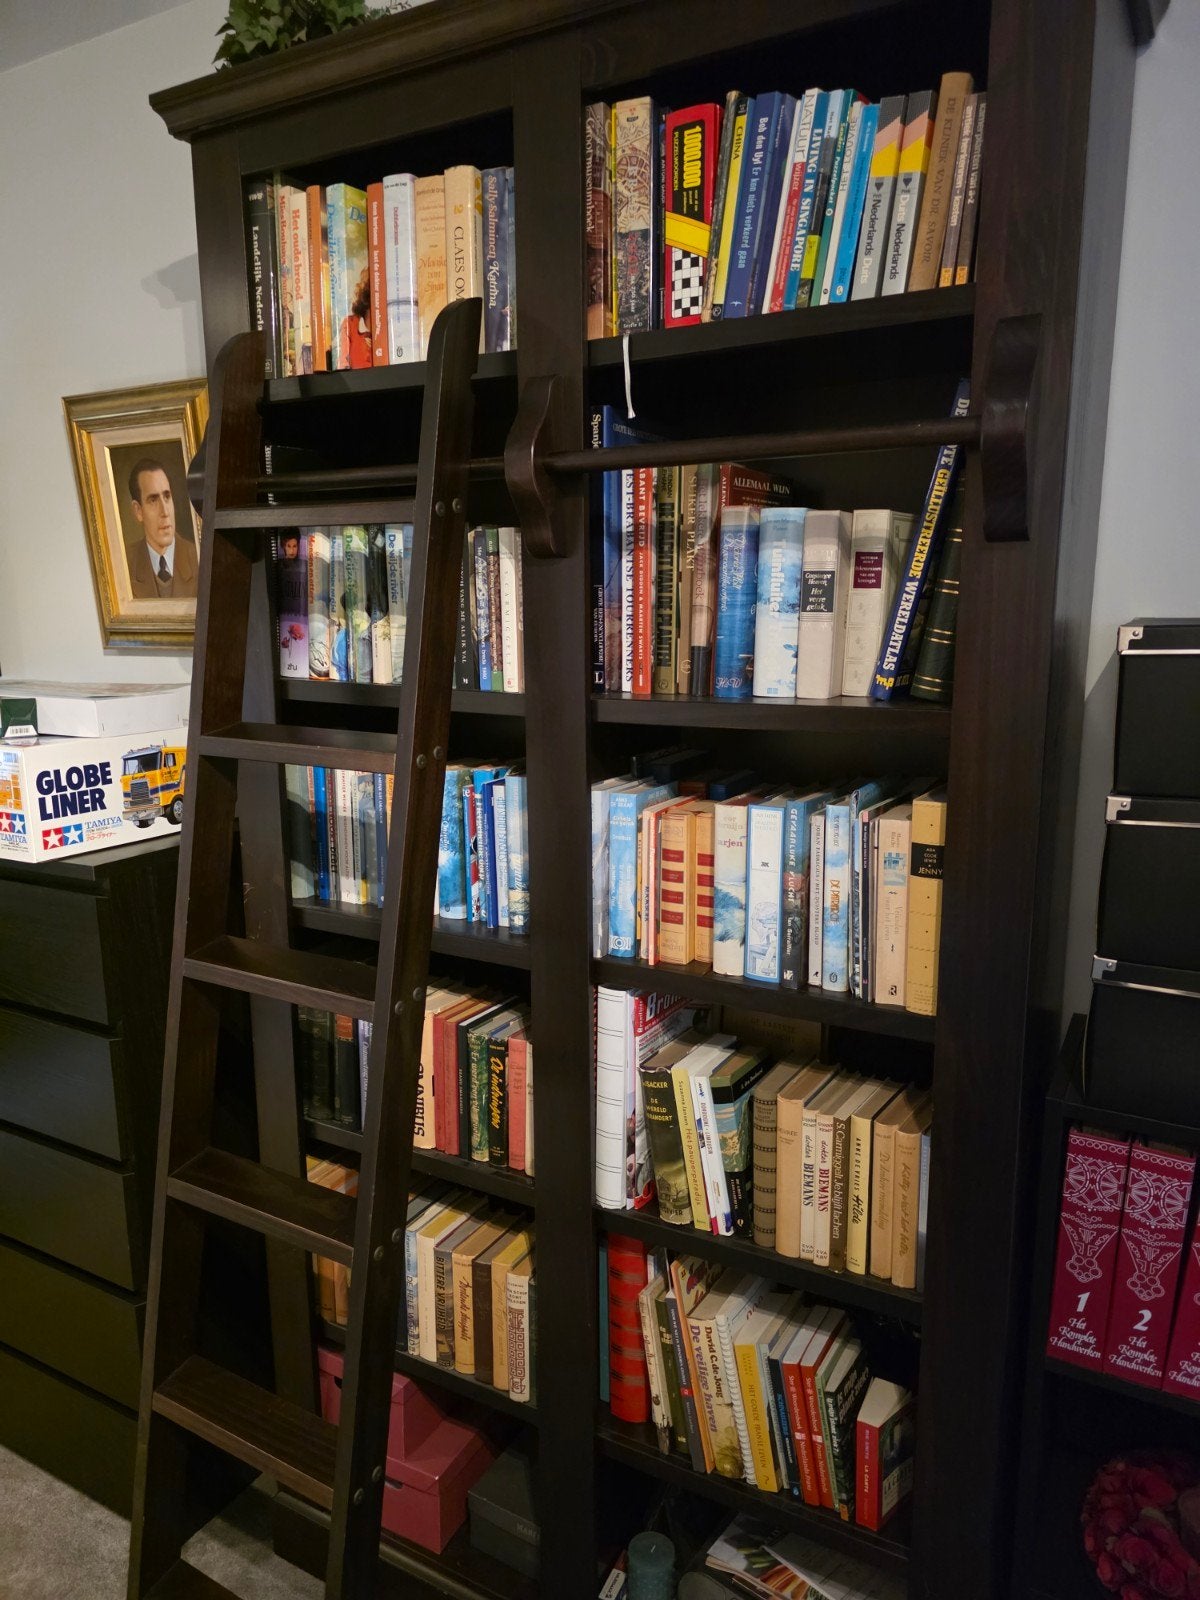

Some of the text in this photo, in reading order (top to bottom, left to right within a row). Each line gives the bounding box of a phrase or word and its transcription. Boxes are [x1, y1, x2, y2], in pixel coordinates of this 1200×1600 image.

[946, 97, 956, 113] DE
[733, 126, 744, 160] CHINA
[938, 119, 954, 163] KLINIEK
[585, 118, 595, 232] Groot museumboek
[828, 122, 846, 203] Sanders Puzzelpocket
[950, 106, 973, 226] antiek herkennen kasten
[737, 117, 768, 268] Bob den Uyl Er niets verkeerd gaan
[933, 168, 945, 195] VAN
[970, 173, 978, 187] van
[790, 128, 823, 271] LIVING IN SINGAPORE
[967, 190, 976, 204] a-z
[291, 209, 300, 231] Het
[292, 234, 301, 257] oude
[487, 176, 499, 309] Sally Salminen Katrina
[860, 199, 881, 284] Nederlands Duits
[889, 194, 908, 279] Duits Nederlands
[251, 226, 264, 331] Landelijk Nederla
[454, 226, 465, 300] CLAES OM
[293, 259, 303, 301] brood
[734, 478, 790, 495] ALLEMAAL WIJN
[625, 473, 634, 581] EST-BRABANTSE
[638, 505, 646, 547] BEVRIJD
[685, 475, 697, 571] SUIKER PLAKT
[696, 500, 707, 539] lekkere
[882, 398, 969, 670] DE GEÏLLUSTREERDE WERELDATLAS
[388, 534, 399, 605] De wijde rivier
[657, 502, 674, 667] DE MACHT VAN DE PLANTEN
[460, 611, 466, 622] ME
[461, 640, 466, 648] IK
[36, 761, 112, 796] GLOBE
[38, 787, 107, 821] LINER
[84, 816, 122, 829] TAMIYA
[787, 871, 796, 903] VLUCHT
[919, 867, 943, 875] JENNY
[472, 1052, 479, 1061] Er
[490, 1057, 504, 1071] De
[685, 1128, 693, 1143] Het
[802, 1135, 814, 1207] dokter BIEMANS
[832, 1131, 845, 1179] Carmiggelt
[854, 1158, 861, 1168] DE
[686, 1145, 702, 1205] pauperparadijs
[818, 1140, 829, 1212] dokter BIEMANS
[834, 1180, 843, 1190] Je
[832, 1210, 841, 1239] lachen
[852, 1195, 864, 1224] Hilde
[436, 1257, 446, 1330] BITTERE VRIJHEID
[1076, 1292, 1090, 1312] 1
[1059, 1325, 1097, 1344] Komplete
[1068, 1318, 1087, 1330] Het
[1133, 1309, 1152, 1331] 2
[1049, 1335, 1101, 1359] Handwerken
[1118, 1344, 1158, 1362] Komplete
[1129, 1336, 1147, 1348] Het
[704, 1326, 724, 1398] David C. de Jong
[1108, 1354, 1163, 1378] Handwerken
[689, 1325, 719, 1433] De veilige haven
[748, 1385, 756, 1398] HET
[788, 1375, 796, 1386] Ster
[749, 1399, 760, 1421] GOEDE
[791, 1393, 802, 1430] Woordenboek
[757, 1449, 767, 1468] LEVEN
[799, 1441, 809, 1473] Nederlands
[808, 1395, 819, 1432] Woordenboek
[817, 1460, 828, 1493] Nederlands
